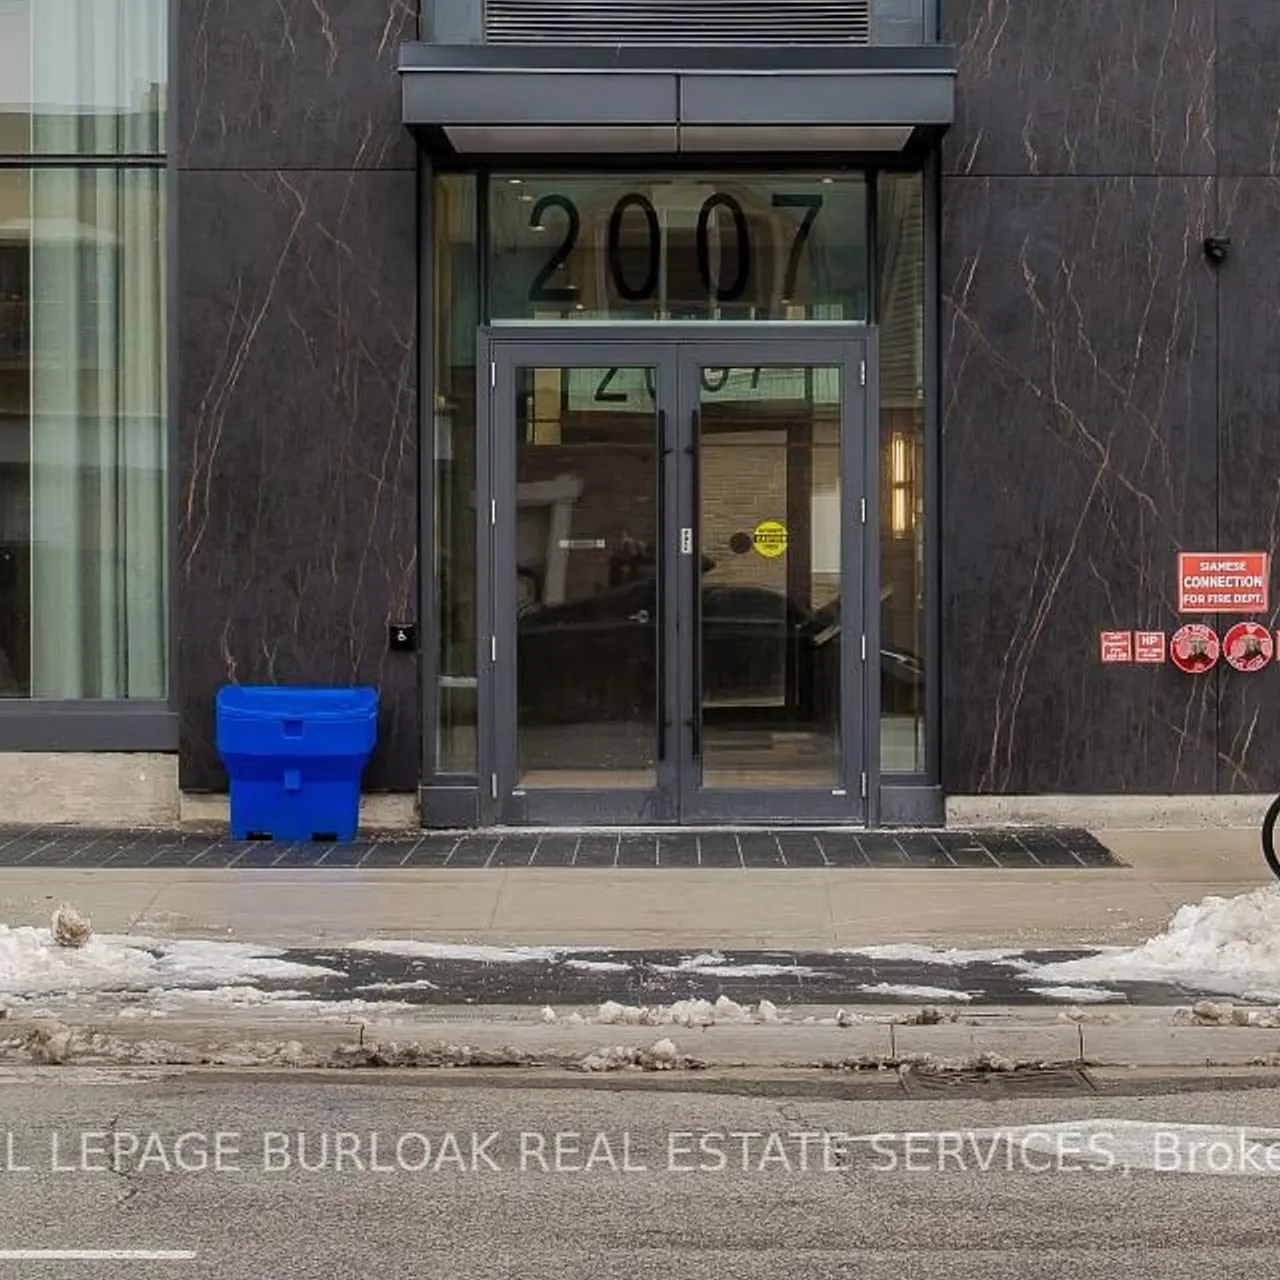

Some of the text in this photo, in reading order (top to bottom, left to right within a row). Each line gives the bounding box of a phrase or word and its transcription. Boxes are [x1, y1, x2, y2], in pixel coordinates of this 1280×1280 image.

[528, 193, 823, 302] 2007
[1200, 561, 1247, 572] SIAMESE
[1184, 575, 1263, 588] CONNECTION
[1184, 593, 1264, 604] FOR FIRE DEPT.
